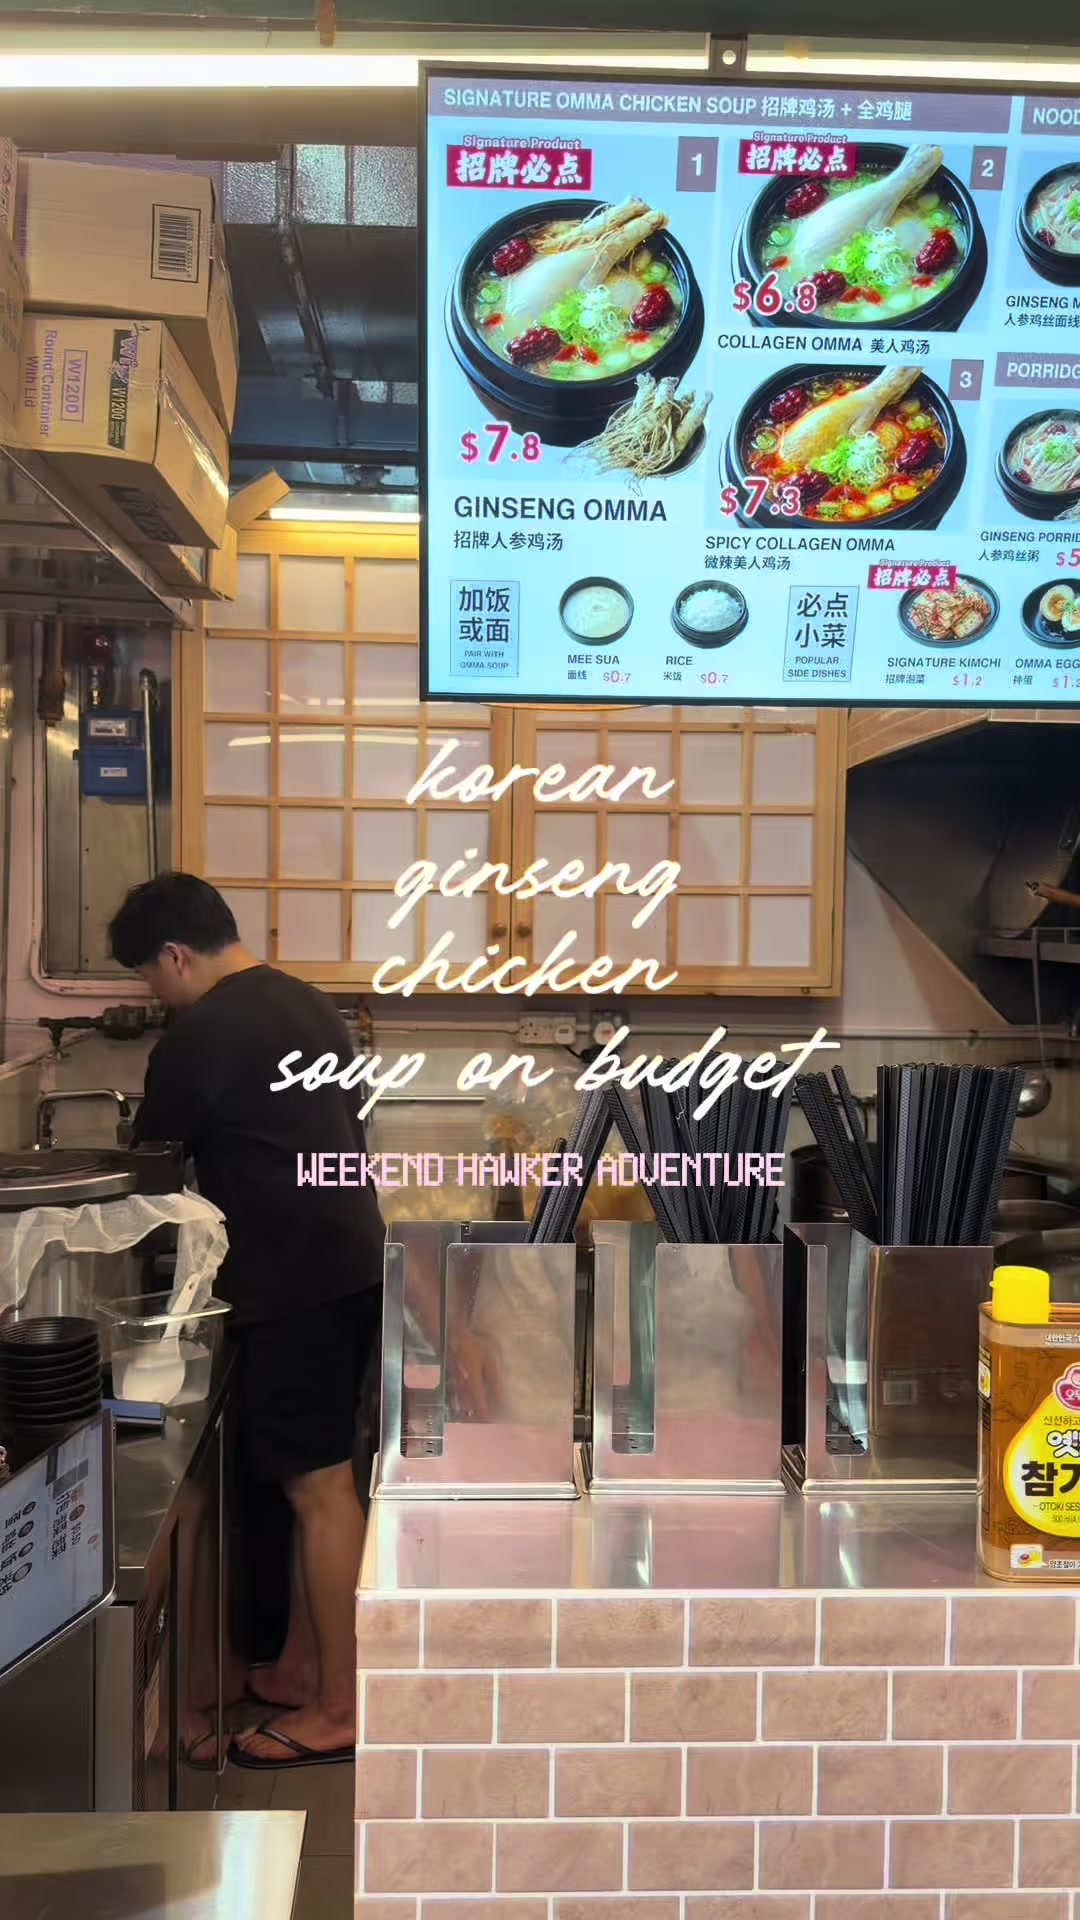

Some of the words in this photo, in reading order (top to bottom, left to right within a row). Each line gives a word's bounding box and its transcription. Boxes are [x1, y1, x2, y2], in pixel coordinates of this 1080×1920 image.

[444, 88, 551, 109] SIGNATURE
[556, 93, 614, 111] OMMA
[619, 94, 700, 114] CHICKEN
[706, 97, 757, 115] SOUP
[761, 96, 835, 118] 招牌鸡汤
[857, 99, 912, 121] 全鸡腿
[463, 135, 527, 150] Signature
[530, 136, 580, 150] Product
[753, 131, 804, 143] Signature
[807, 133, 848, 144] Product
[456, 150, 583, 186] 招牌必点
[691, 153, 704, 177] 1
[745, 143, 848, 173] 招牌必点
[981, 158, 994, 177] 2
[732, 275, 817, 315] $6.8
[1006, 295, 1069, 309] GINSENG
[43, 329, 57, 371] Round
[718, 334, 807, 350] COLLAGEN
[812, 335, 862, 351] OMMA
[870, 338, 930, 354] 美人鸡汤
[65, 358, 81, 413] W1200
[960, 371, 972, 388] 3
[39, 374, 54, 437] Container
[111, 387, 127, 420] W1200
[460, 424, 541, 463] $7.8
[719, 477, 800, 516] $7.3
[454, 496, 575, 520] GINSENG
[584, 499, 667, 521] OMMA
[453, 530, 564, 551] 招牌人参鸡汤
[705, 536, 750, 551] SPICY
[756, 537, 841, 552] COLLAGEN
[846, 538, 895, 552] OMMA
[980, 531, 1035, 543] GINSENG
[704, 555, 790, 571] 微辣美人鸡汤
[978, 549, 1040, 562] 人参鸡丝粥
[873, 568, 950, 588] 招牌必点
[458, 586, 510, 613] 加饭
[796, 592, 849, 618] 必点
[458, 616, 510, 643] 或面
[794, 623, 847, 648] 小菜
[567, 654, 592, 664] MEE
[595, 655, 620, 665] SUA
[665, 656, 693, 666] RICE
[795, 656, 840, 665] POPULAR
[887, 658, 956, 668] SIGNATURE
[959, 658, 1001, 668] KIMCHI
[1015, 658, 1052, 669] OMMA
[787, 669, 809, 678] SIDE
[811, 669, 847, 678] DISHES
